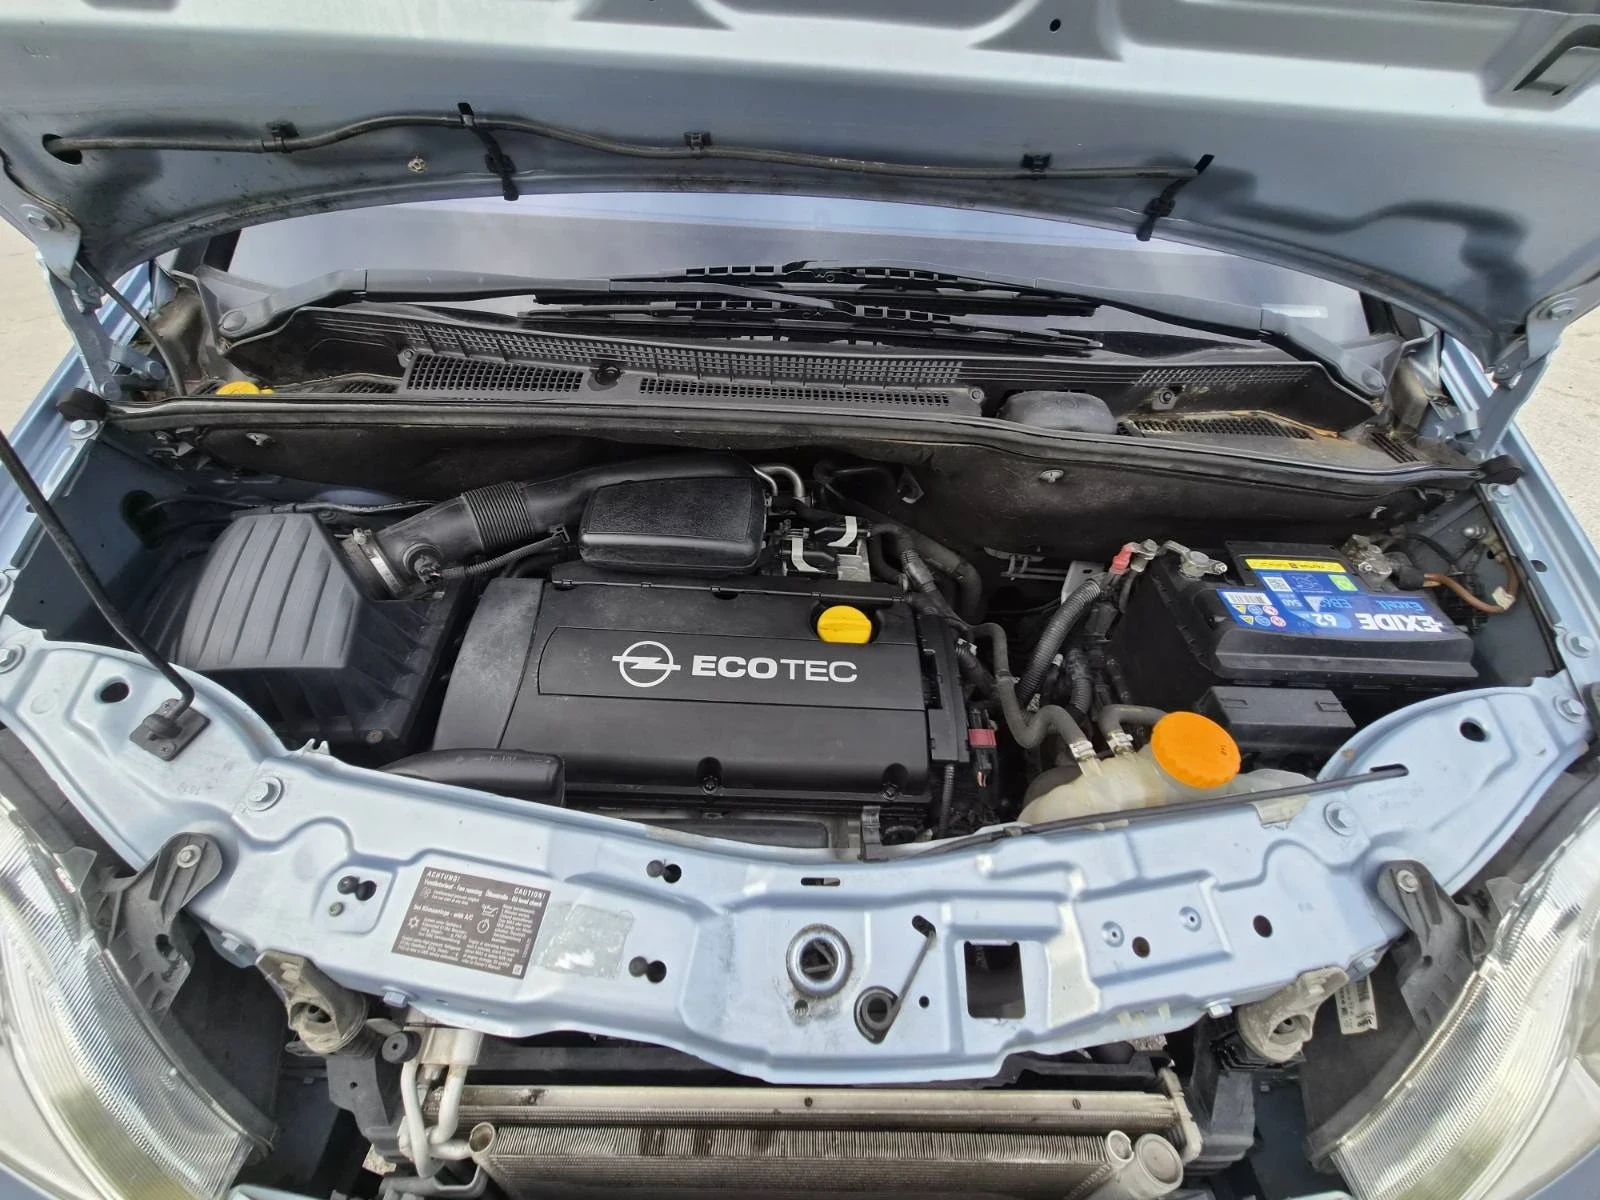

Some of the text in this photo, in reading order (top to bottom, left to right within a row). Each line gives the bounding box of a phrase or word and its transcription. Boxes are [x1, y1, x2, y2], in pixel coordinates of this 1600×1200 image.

[1311, 612, 1338, 628] 62
[1354, 612, 1443, 633] EXIDE
[691, 654, 858, 683] ECOTEC
[426, 870, 461, 882] ACHTUNG!
[514, 887, 546, 900] CAUTION!
